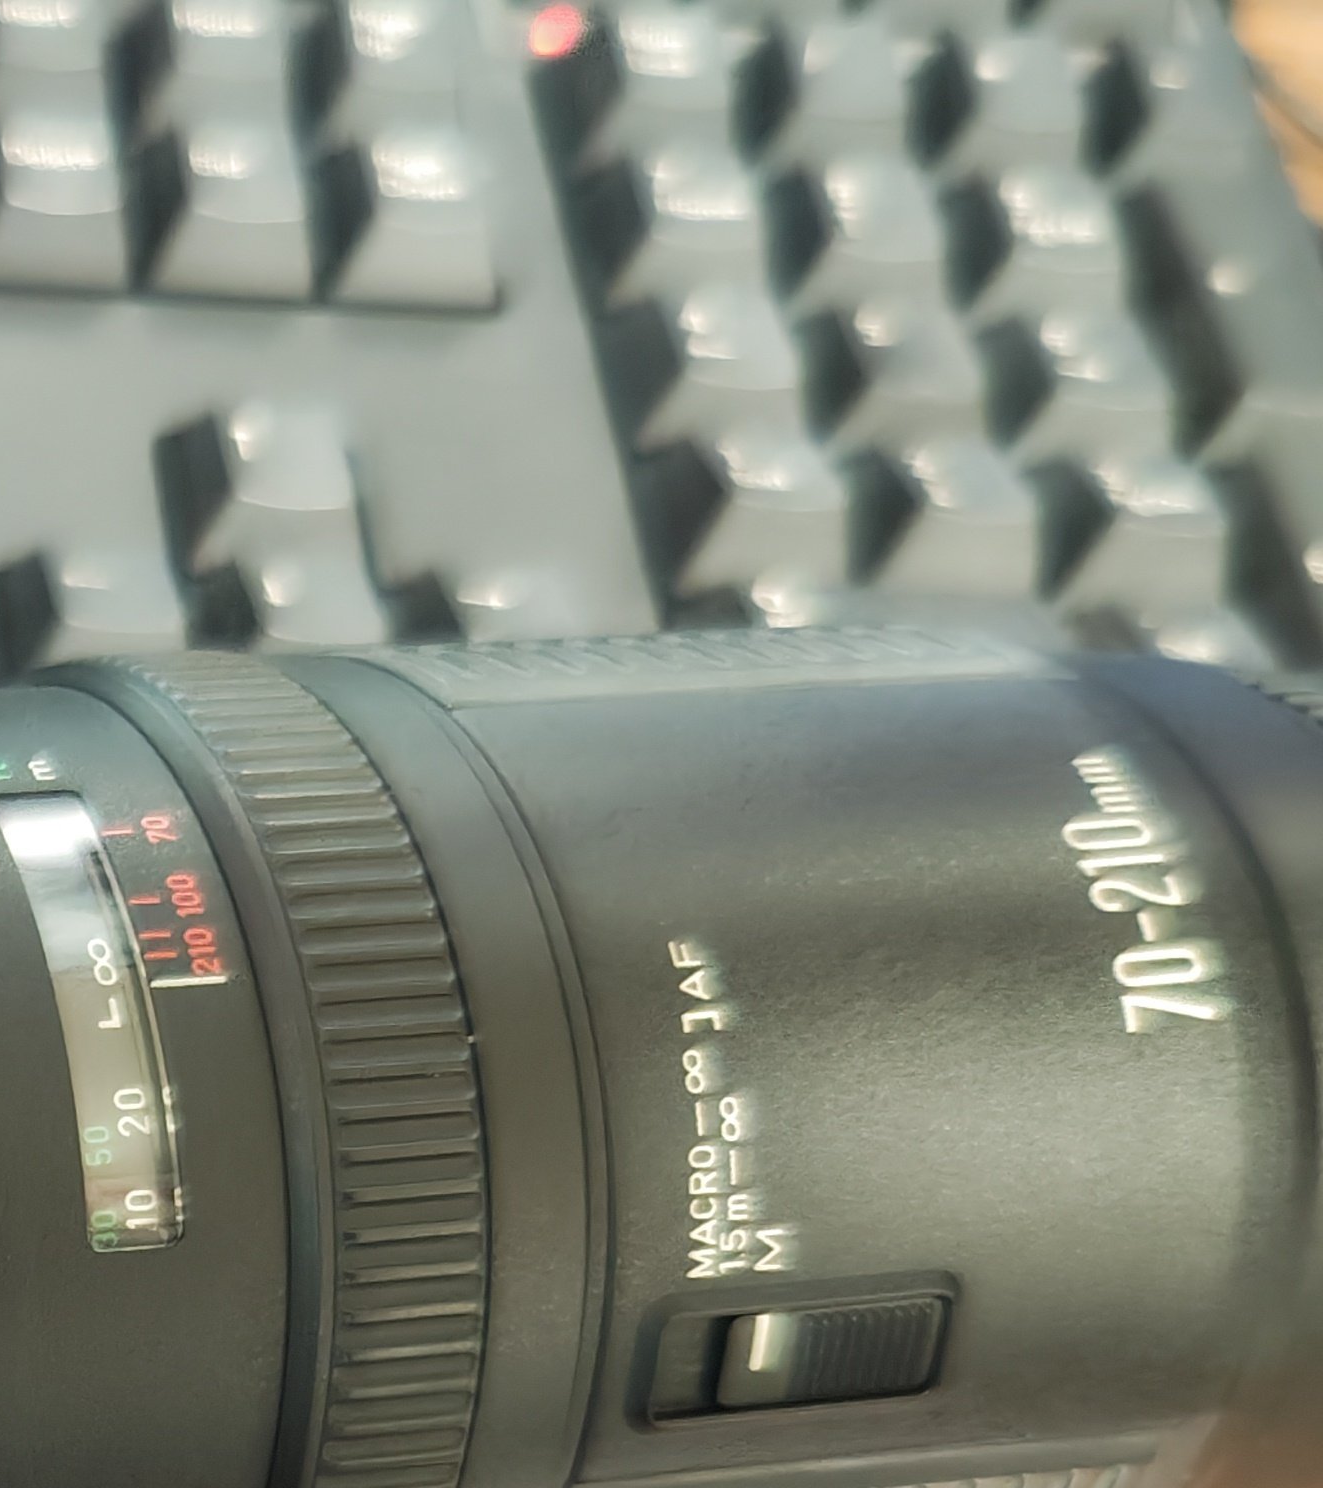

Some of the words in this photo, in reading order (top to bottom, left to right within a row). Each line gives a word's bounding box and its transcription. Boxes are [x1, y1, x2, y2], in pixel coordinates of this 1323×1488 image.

[141, 815, 178, 844] 70
[165, 873, 205, 918] 100
[182, 927, 223, 976] 210
[667, 940, 713, 1001] AF
[113, 1087, 152, 1137] 20
[83, 1125, 112, 1166] 50
[124, 1188, 157, 1231] 10
[753, 1227, 787, 1273] M
